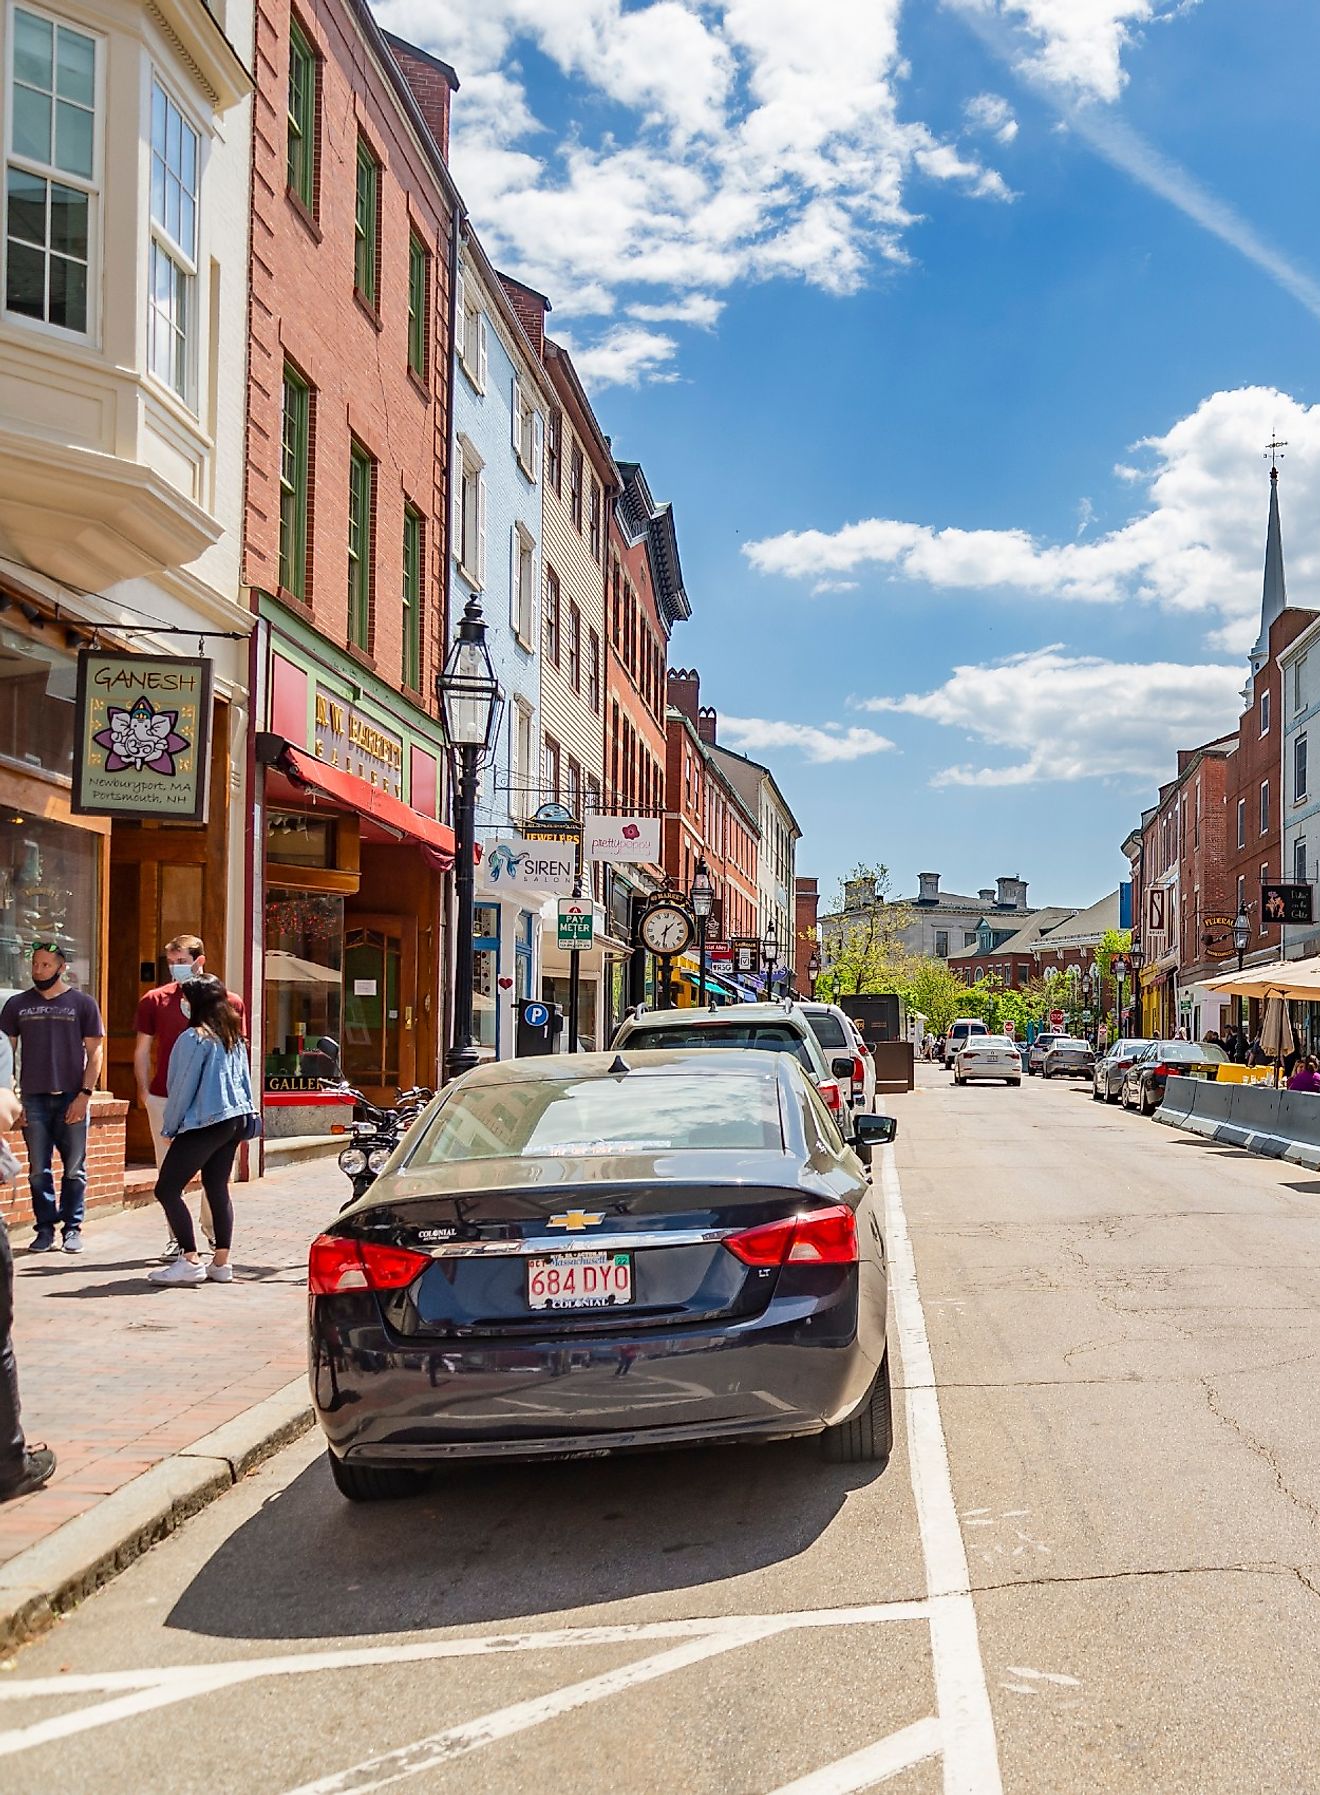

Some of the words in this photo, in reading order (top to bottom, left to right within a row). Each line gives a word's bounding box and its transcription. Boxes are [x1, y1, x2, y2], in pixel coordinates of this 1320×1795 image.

[94, 667, 196, 692] GANESH
[89, 777, 167, 793] Newburyport,
[171, 783, 192, 792] MA
[93, 790, 163, 804] Portsmouth,
[167, 796, 187, 804] NH
[526, 833, 580, 845] JEWELERS
[524, 860, 571, 876] SIREN
[523, 876, 571, 884] SALON
[656, 893, 685, 901] MARKET
[565, 915, 585, 924] PAY
[560, 923, 590, 932] METER
[269, 1078, 334, 1090] GALLER
[418, 1228, 457, 1238] COLONIAL
[758, 1268, 771, 1278] LT
[531, 1268, 576, 1296] 684
[552, 1298, 609, 1309] COLONIAL
